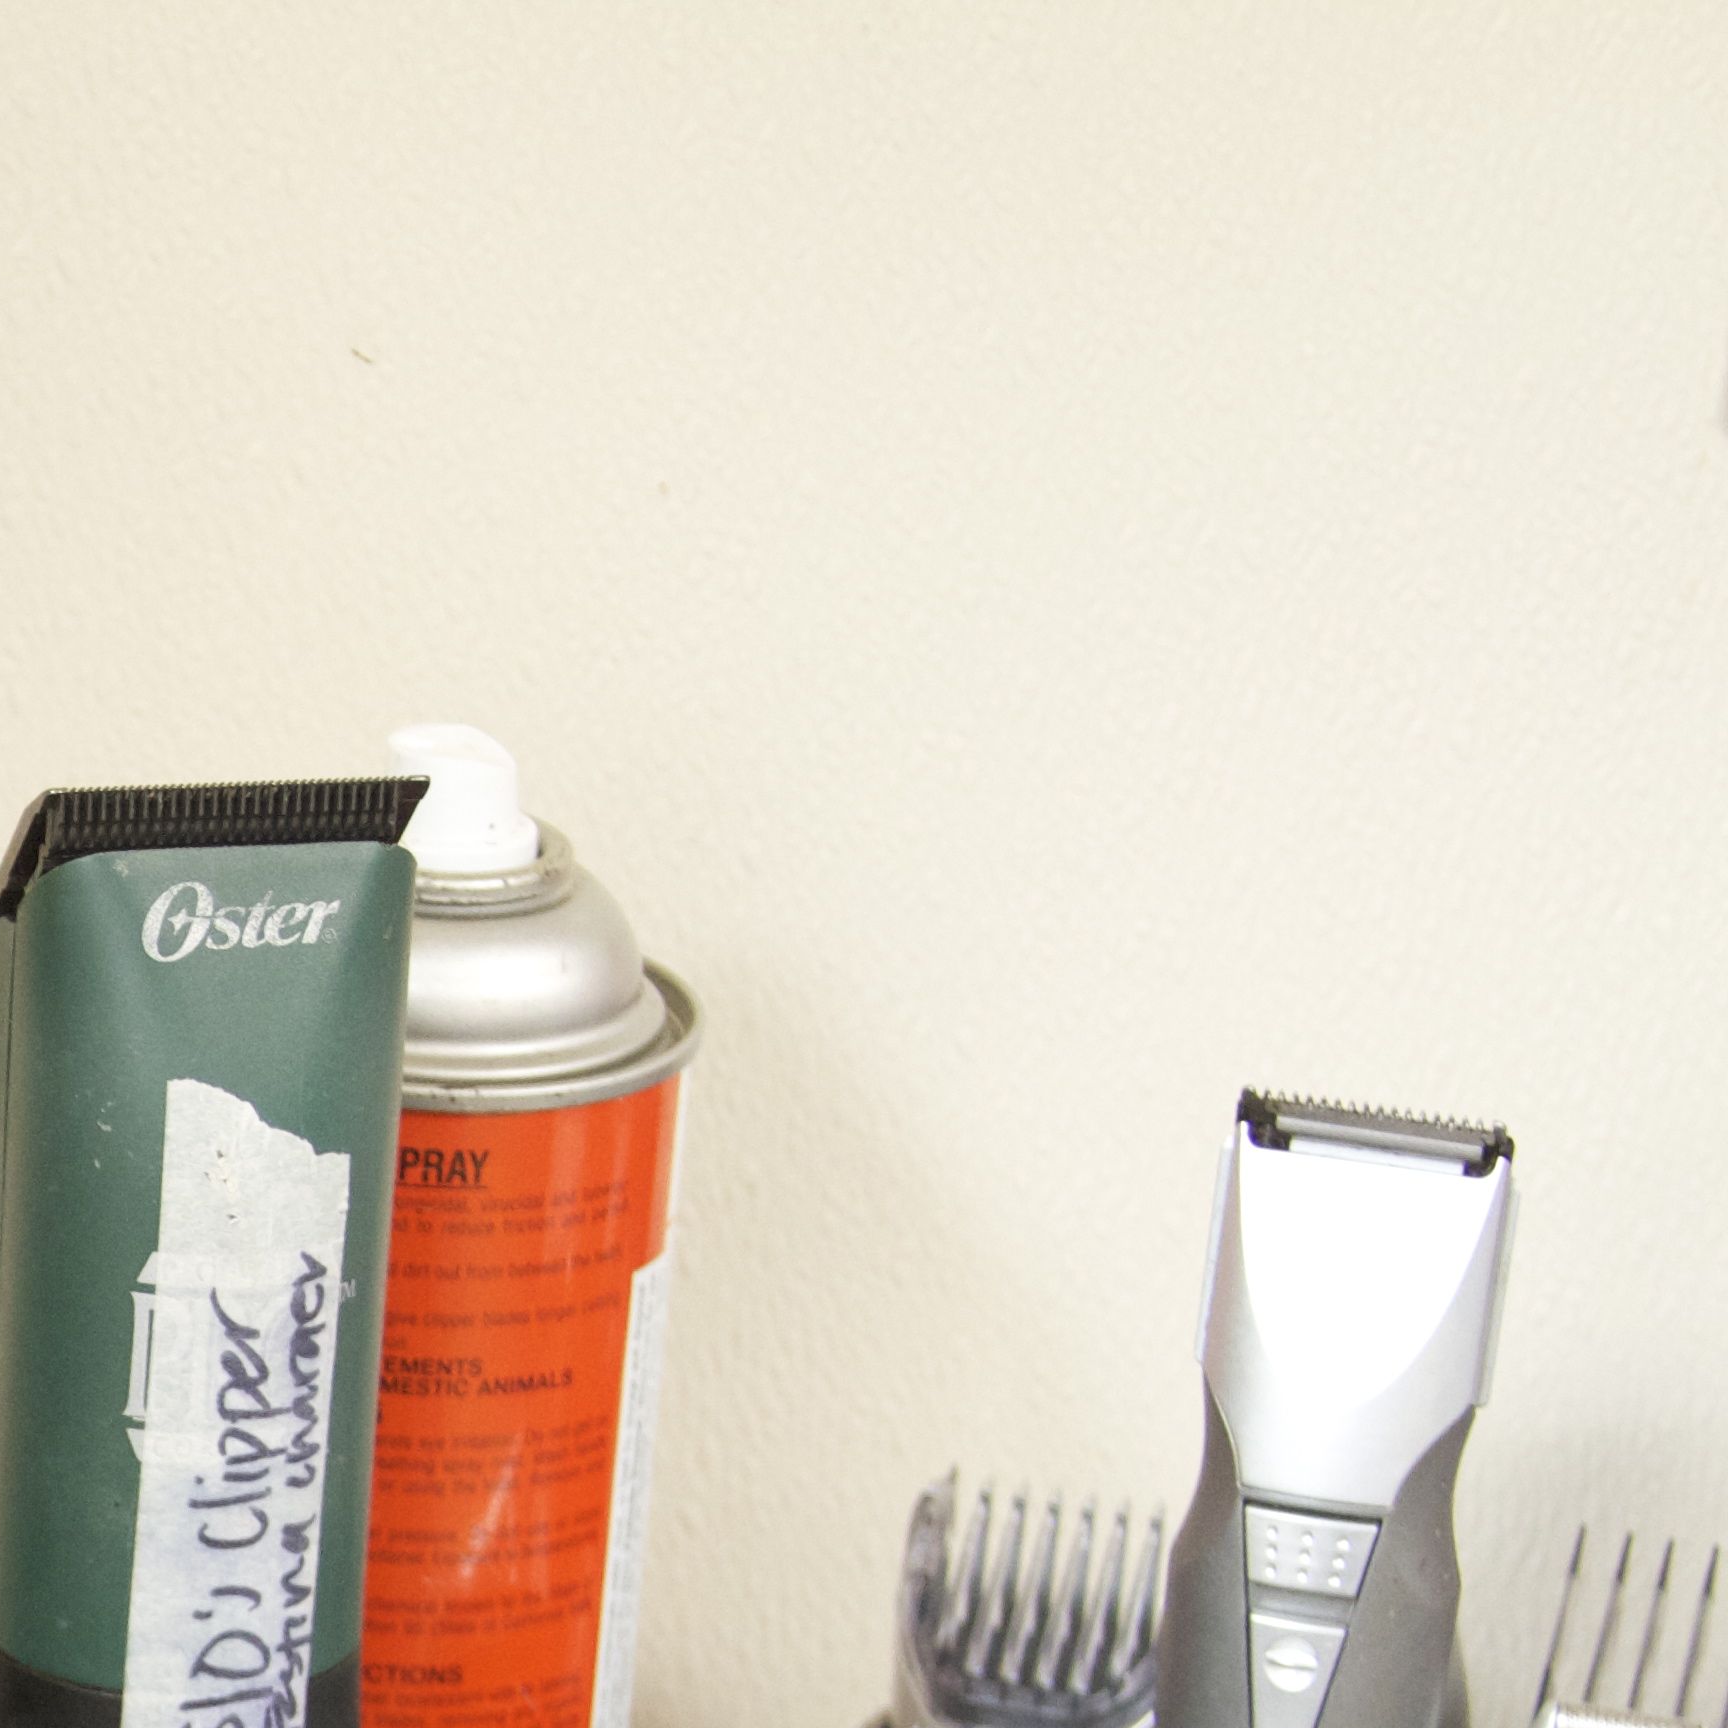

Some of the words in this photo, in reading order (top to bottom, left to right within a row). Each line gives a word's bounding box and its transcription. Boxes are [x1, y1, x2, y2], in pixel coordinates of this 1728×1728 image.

[142, 881, 341, 963] Oster
[187, 1286, 292, 1549] Clipper
[477, 1367, 574, 1396] ANIMALS
